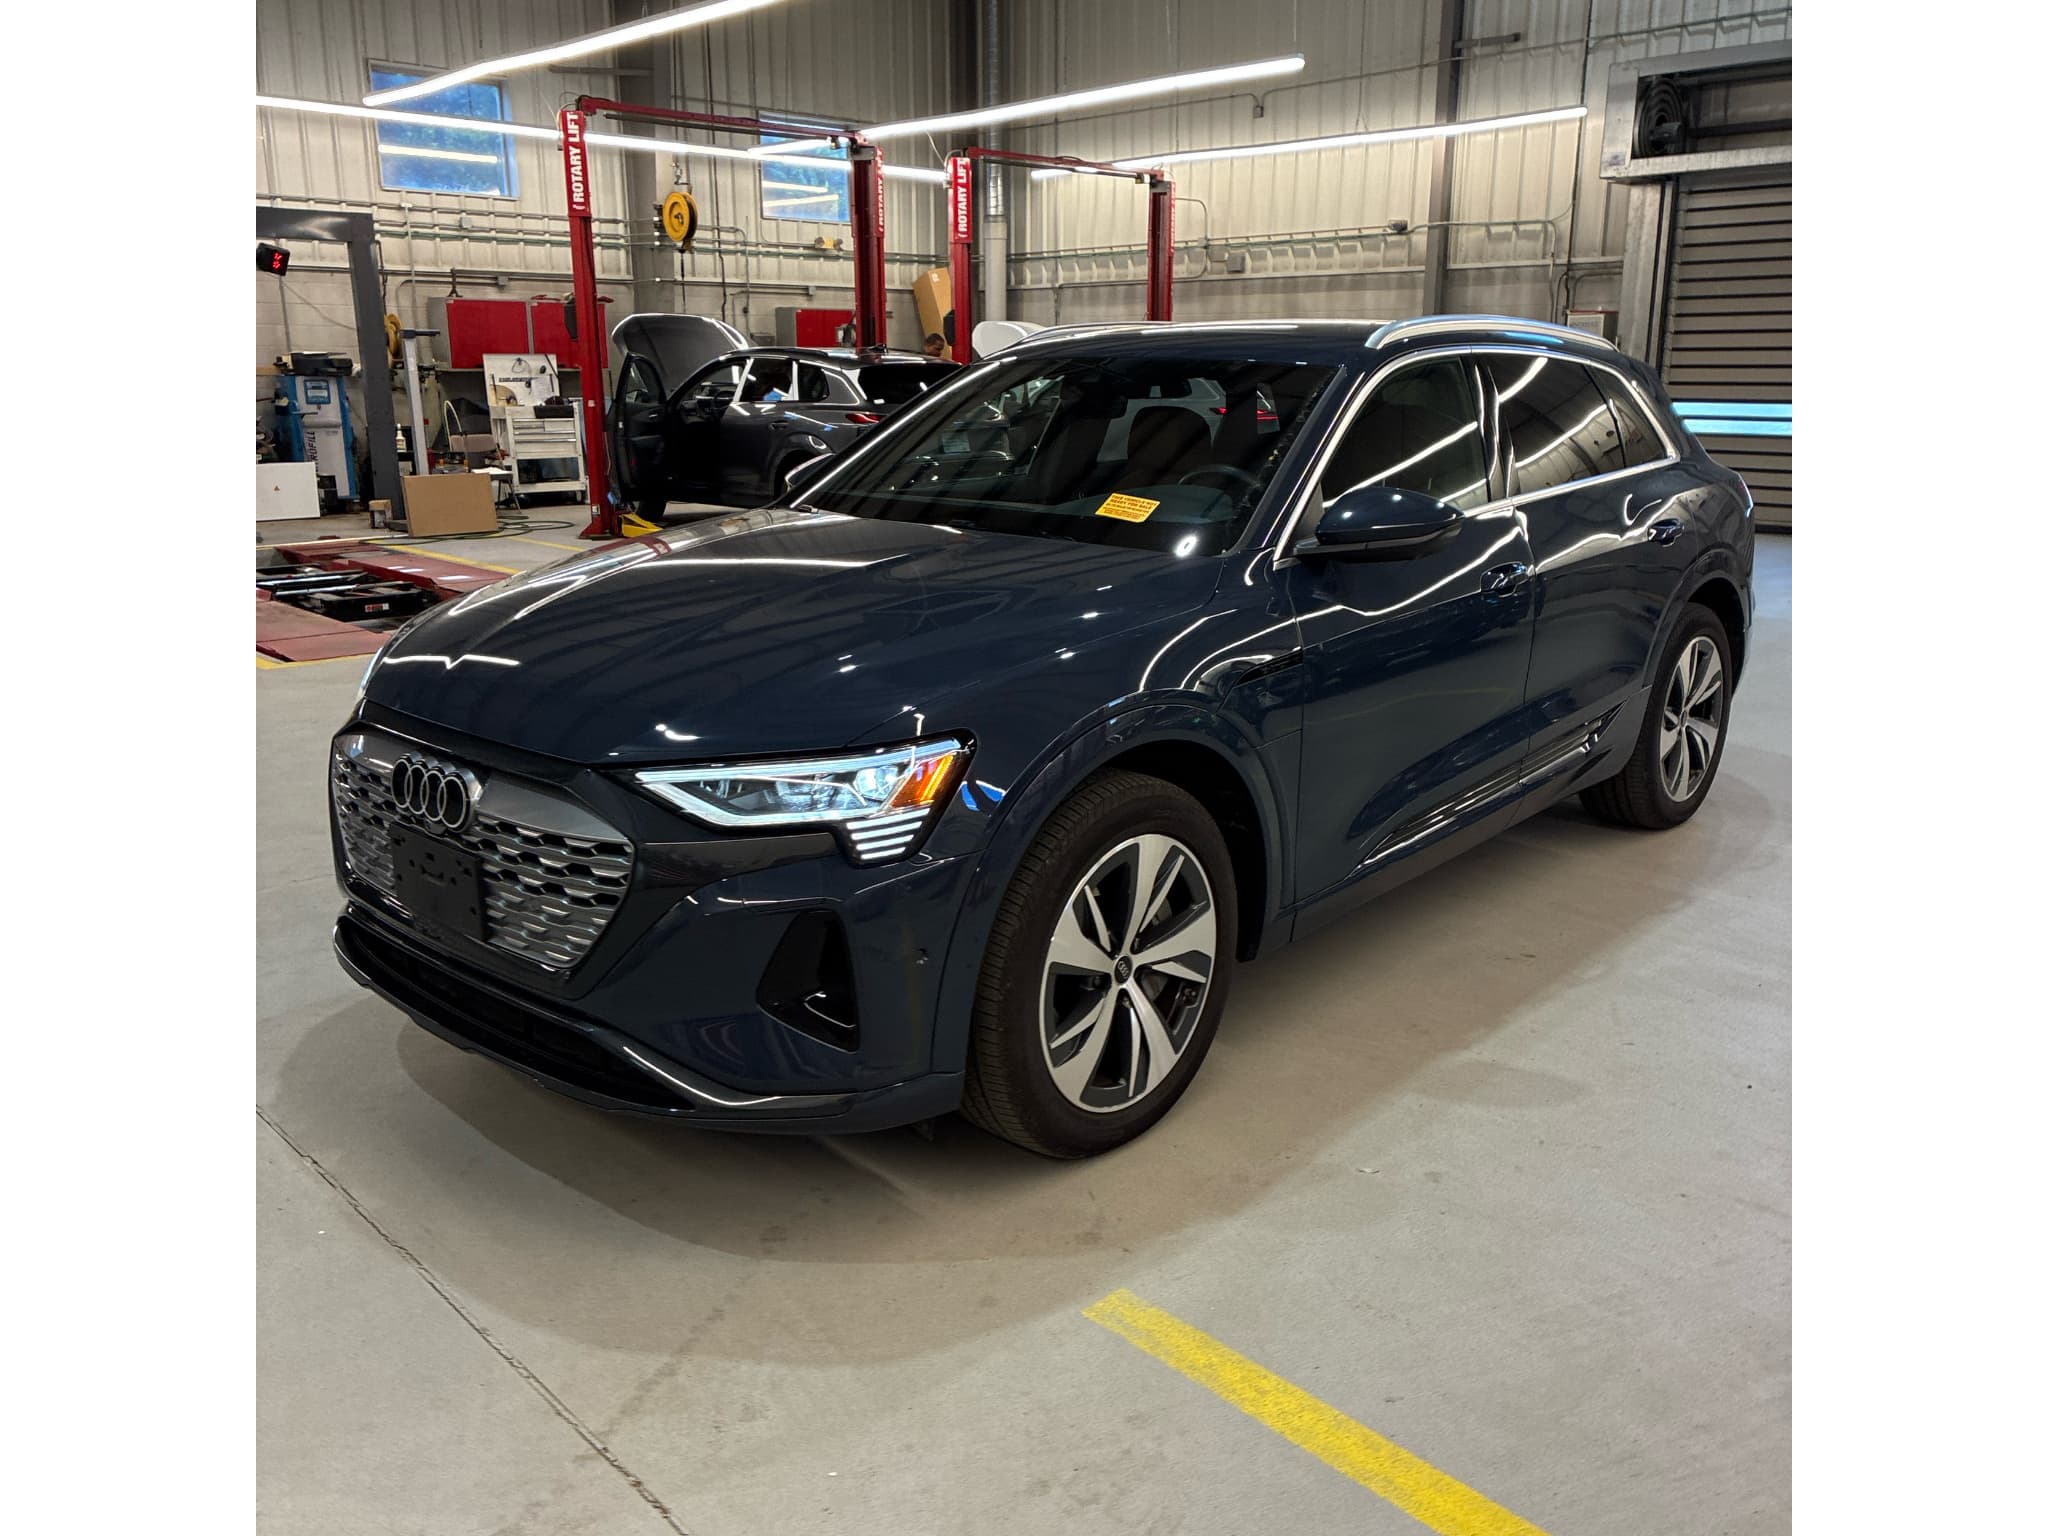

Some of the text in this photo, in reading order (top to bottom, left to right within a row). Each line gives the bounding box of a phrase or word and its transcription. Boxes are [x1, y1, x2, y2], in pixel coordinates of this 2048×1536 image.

[566, 111, 585, 203] ROTARY LIFT
[957, 185, 968, 232] ROTARY
